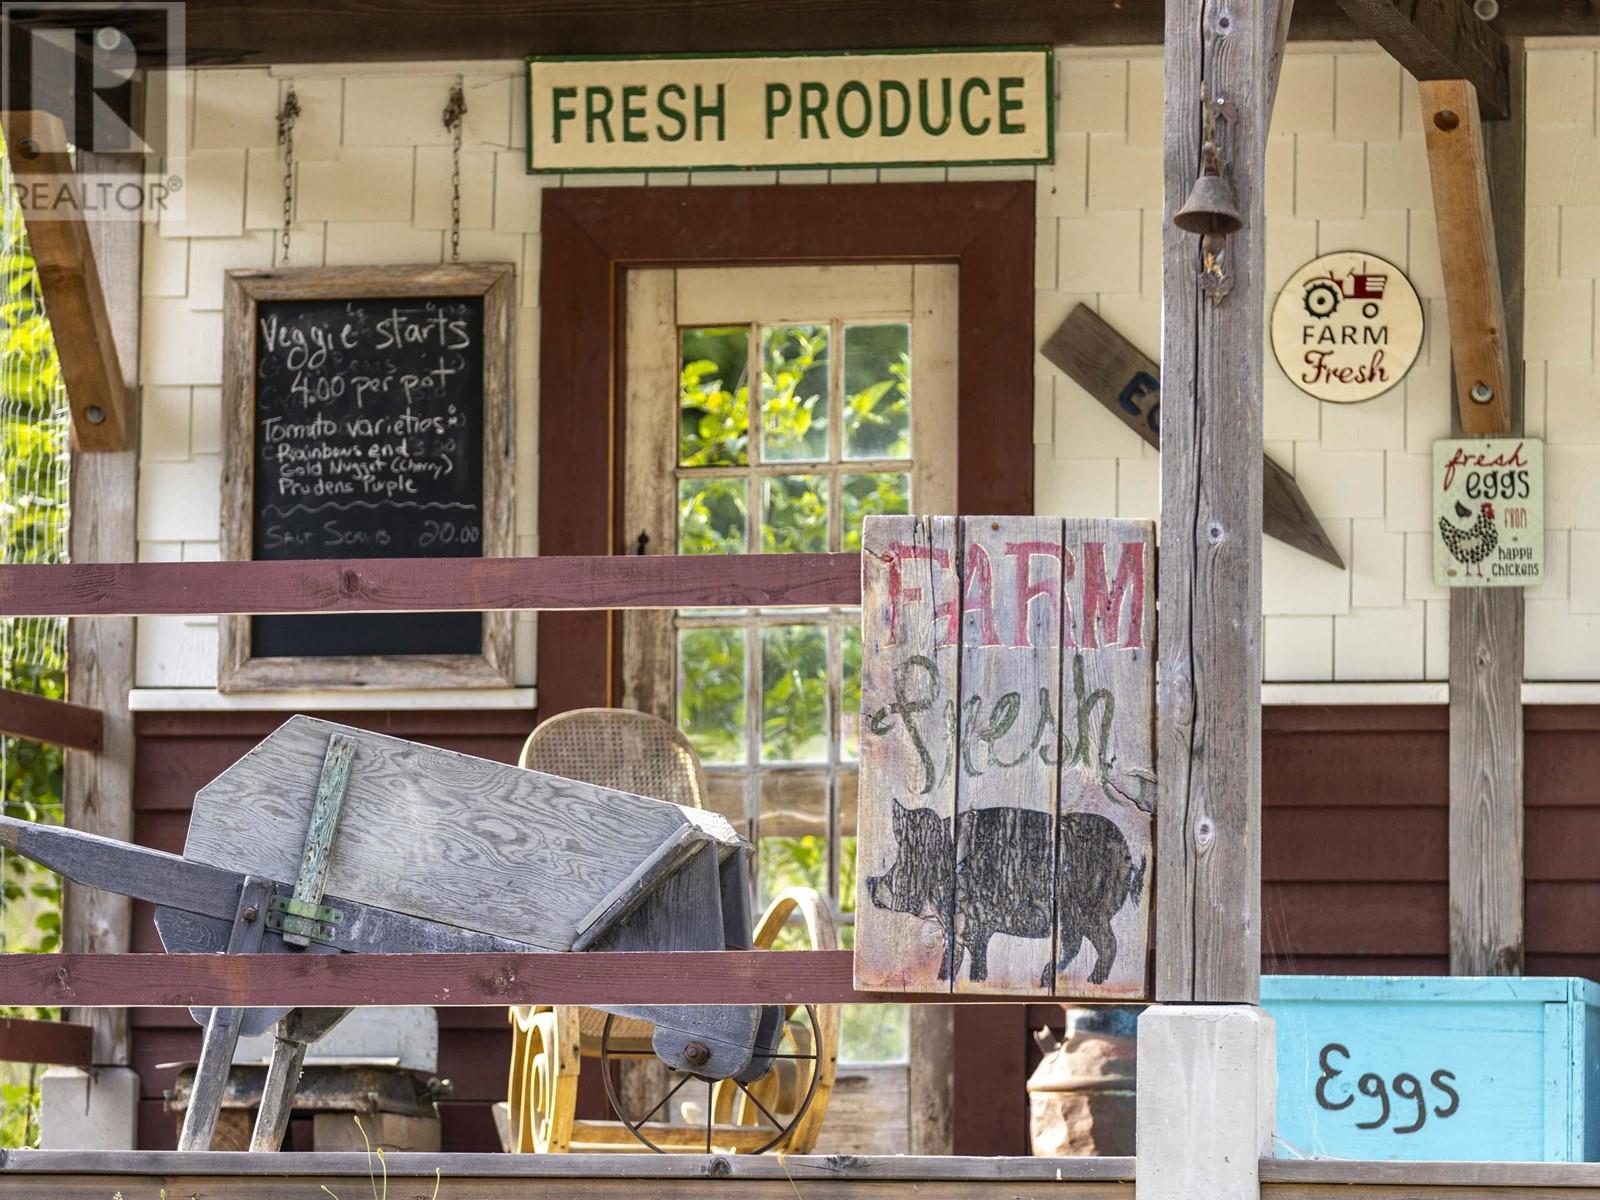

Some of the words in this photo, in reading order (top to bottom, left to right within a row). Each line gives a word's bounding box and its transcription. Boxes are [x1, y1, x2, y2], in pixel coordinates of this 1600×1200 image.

[552, 83, 726, 143] FRESH
[765, 77, 1026, 140] PRODUCE
[260, 313, 358, 371] Veggie
[375, 307, 470, 350] starts
[1302, 325, 1389, 345] FARM
[291, 370, 346, 409] 4.00
[350, 376, 394, 408] per
[400, 356, 455, 404] pot
[1300, 349, 1390, 385] Fresh
[261, 411, 338, 443] Tomato
[368, 437, 410, 458] end
[279, 462, 323, 478] Gold
[1443, 442, 1529, 492] fresh
[278, 476, 355, 496] Prudens
[361, 475, 420, 497] Purple
[1465, 469, 1530, 500] eggs
[418, 520, 480, 547] 20.00
[1497, 546, 1533, 562] happy
[882, 540, 1146, 651] FARM
[868, 653, 1158, 806] Fresh
[1314, 1042, 1461, 1135] Eggs
